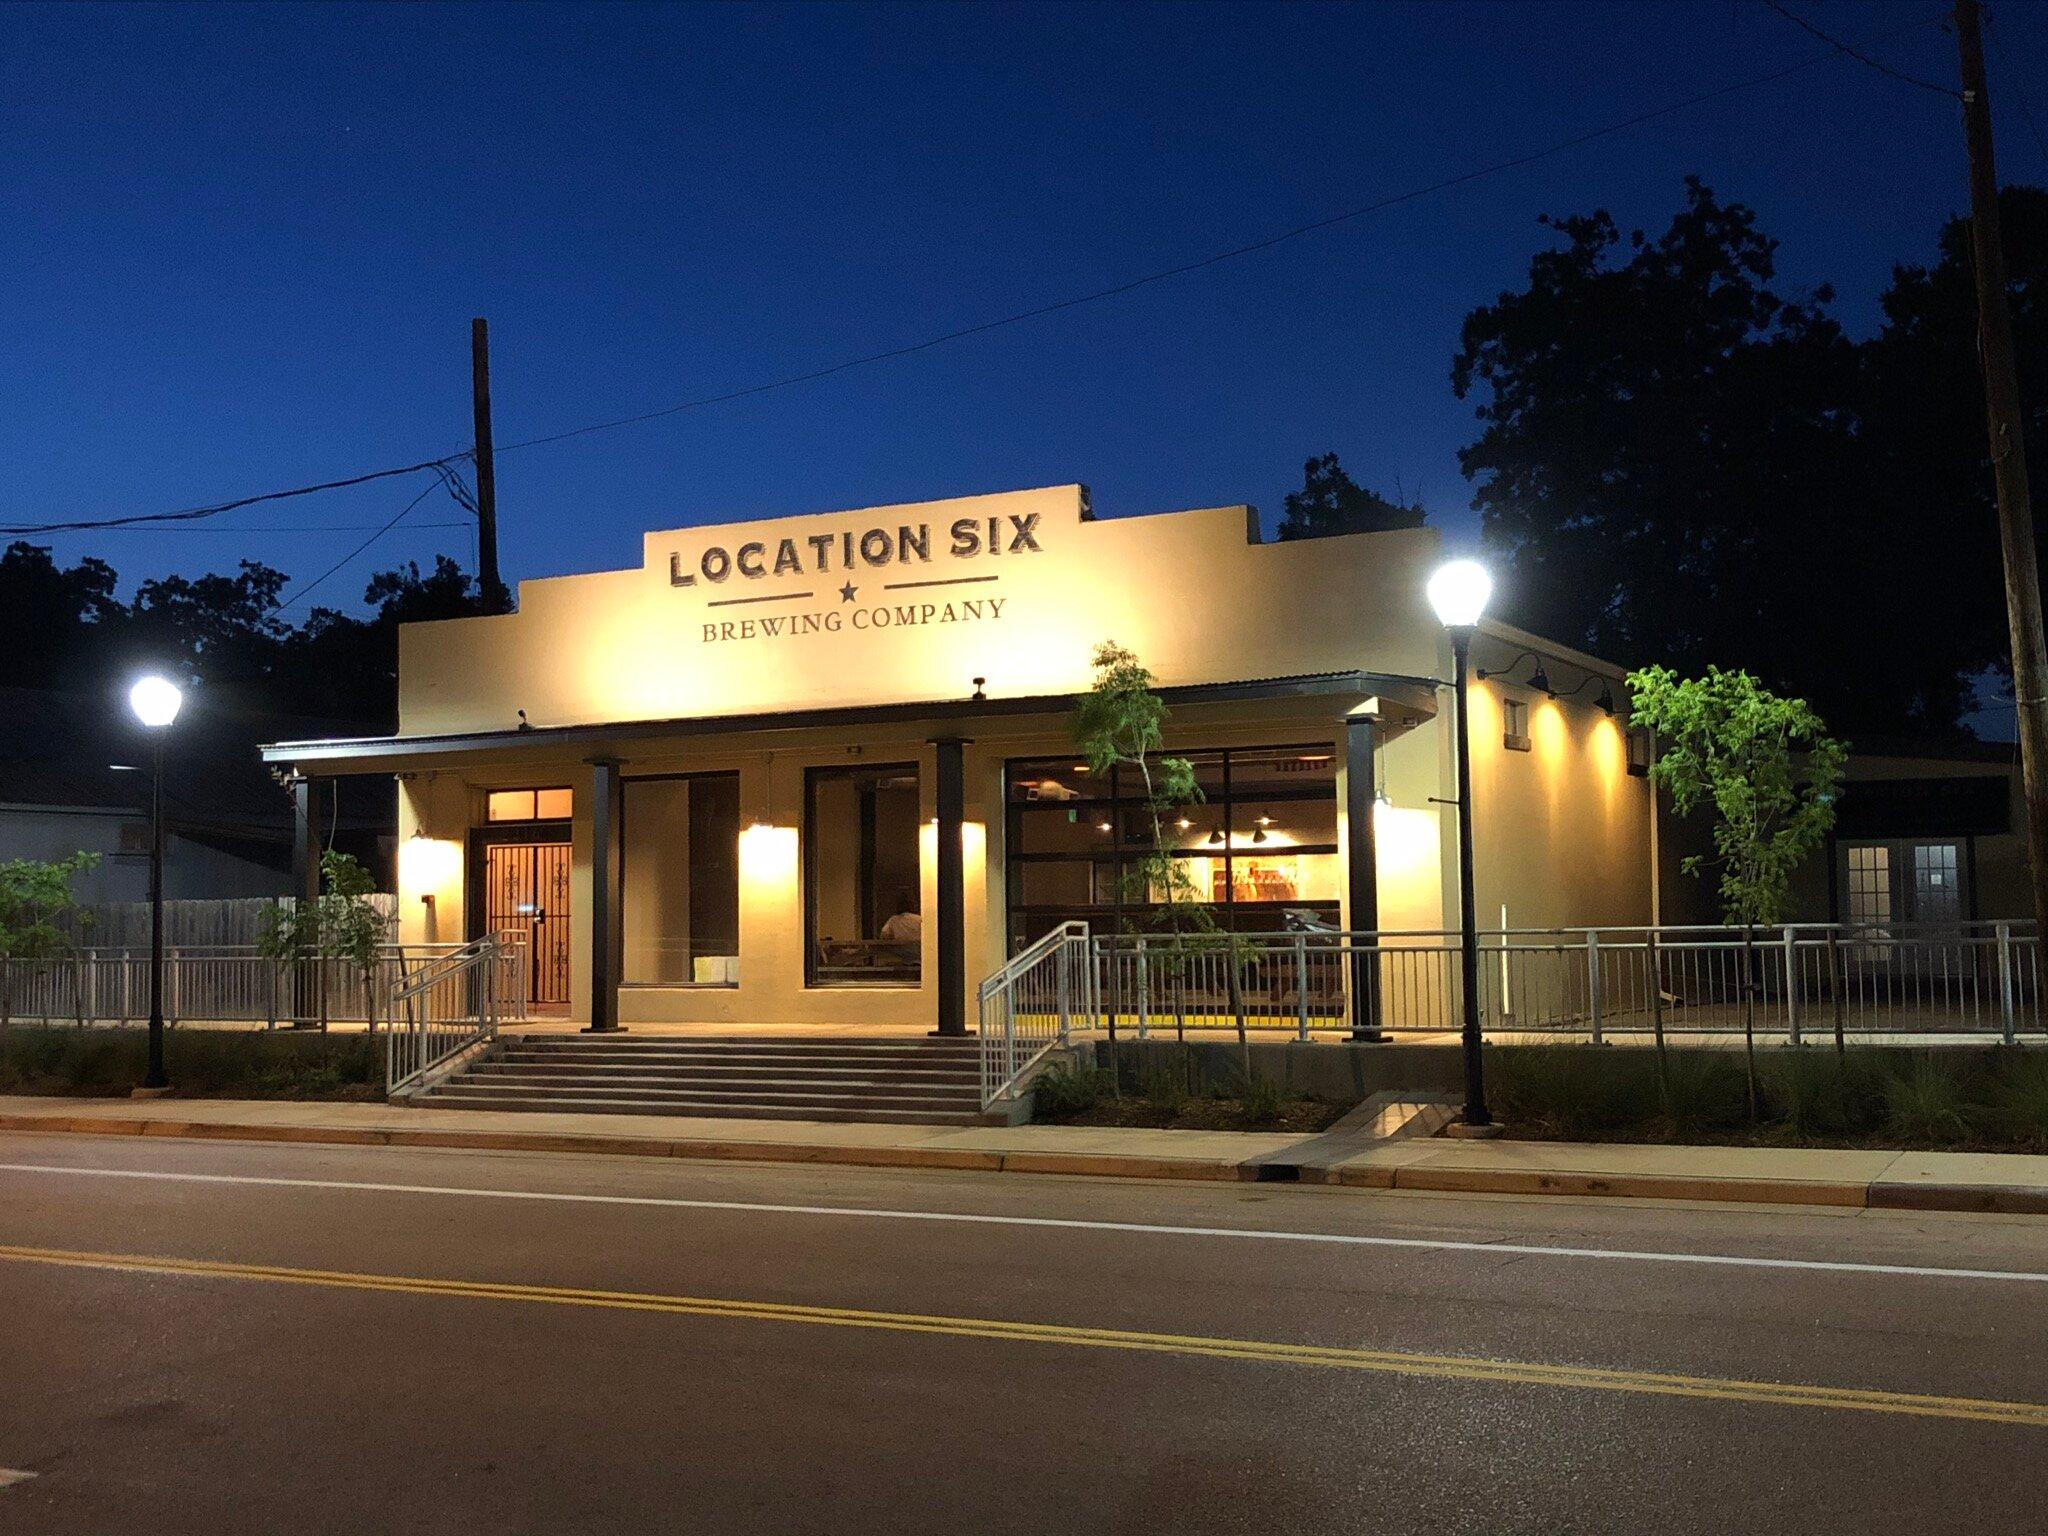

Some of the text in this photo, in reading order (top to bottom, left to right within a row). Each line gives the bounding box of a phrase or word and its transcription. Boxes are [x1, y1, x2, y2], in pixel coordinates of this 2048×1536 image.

[670, 512, 1043, 588] LOCATION SIX
[702, 598, 1007, 643] BREWING COMPANY
